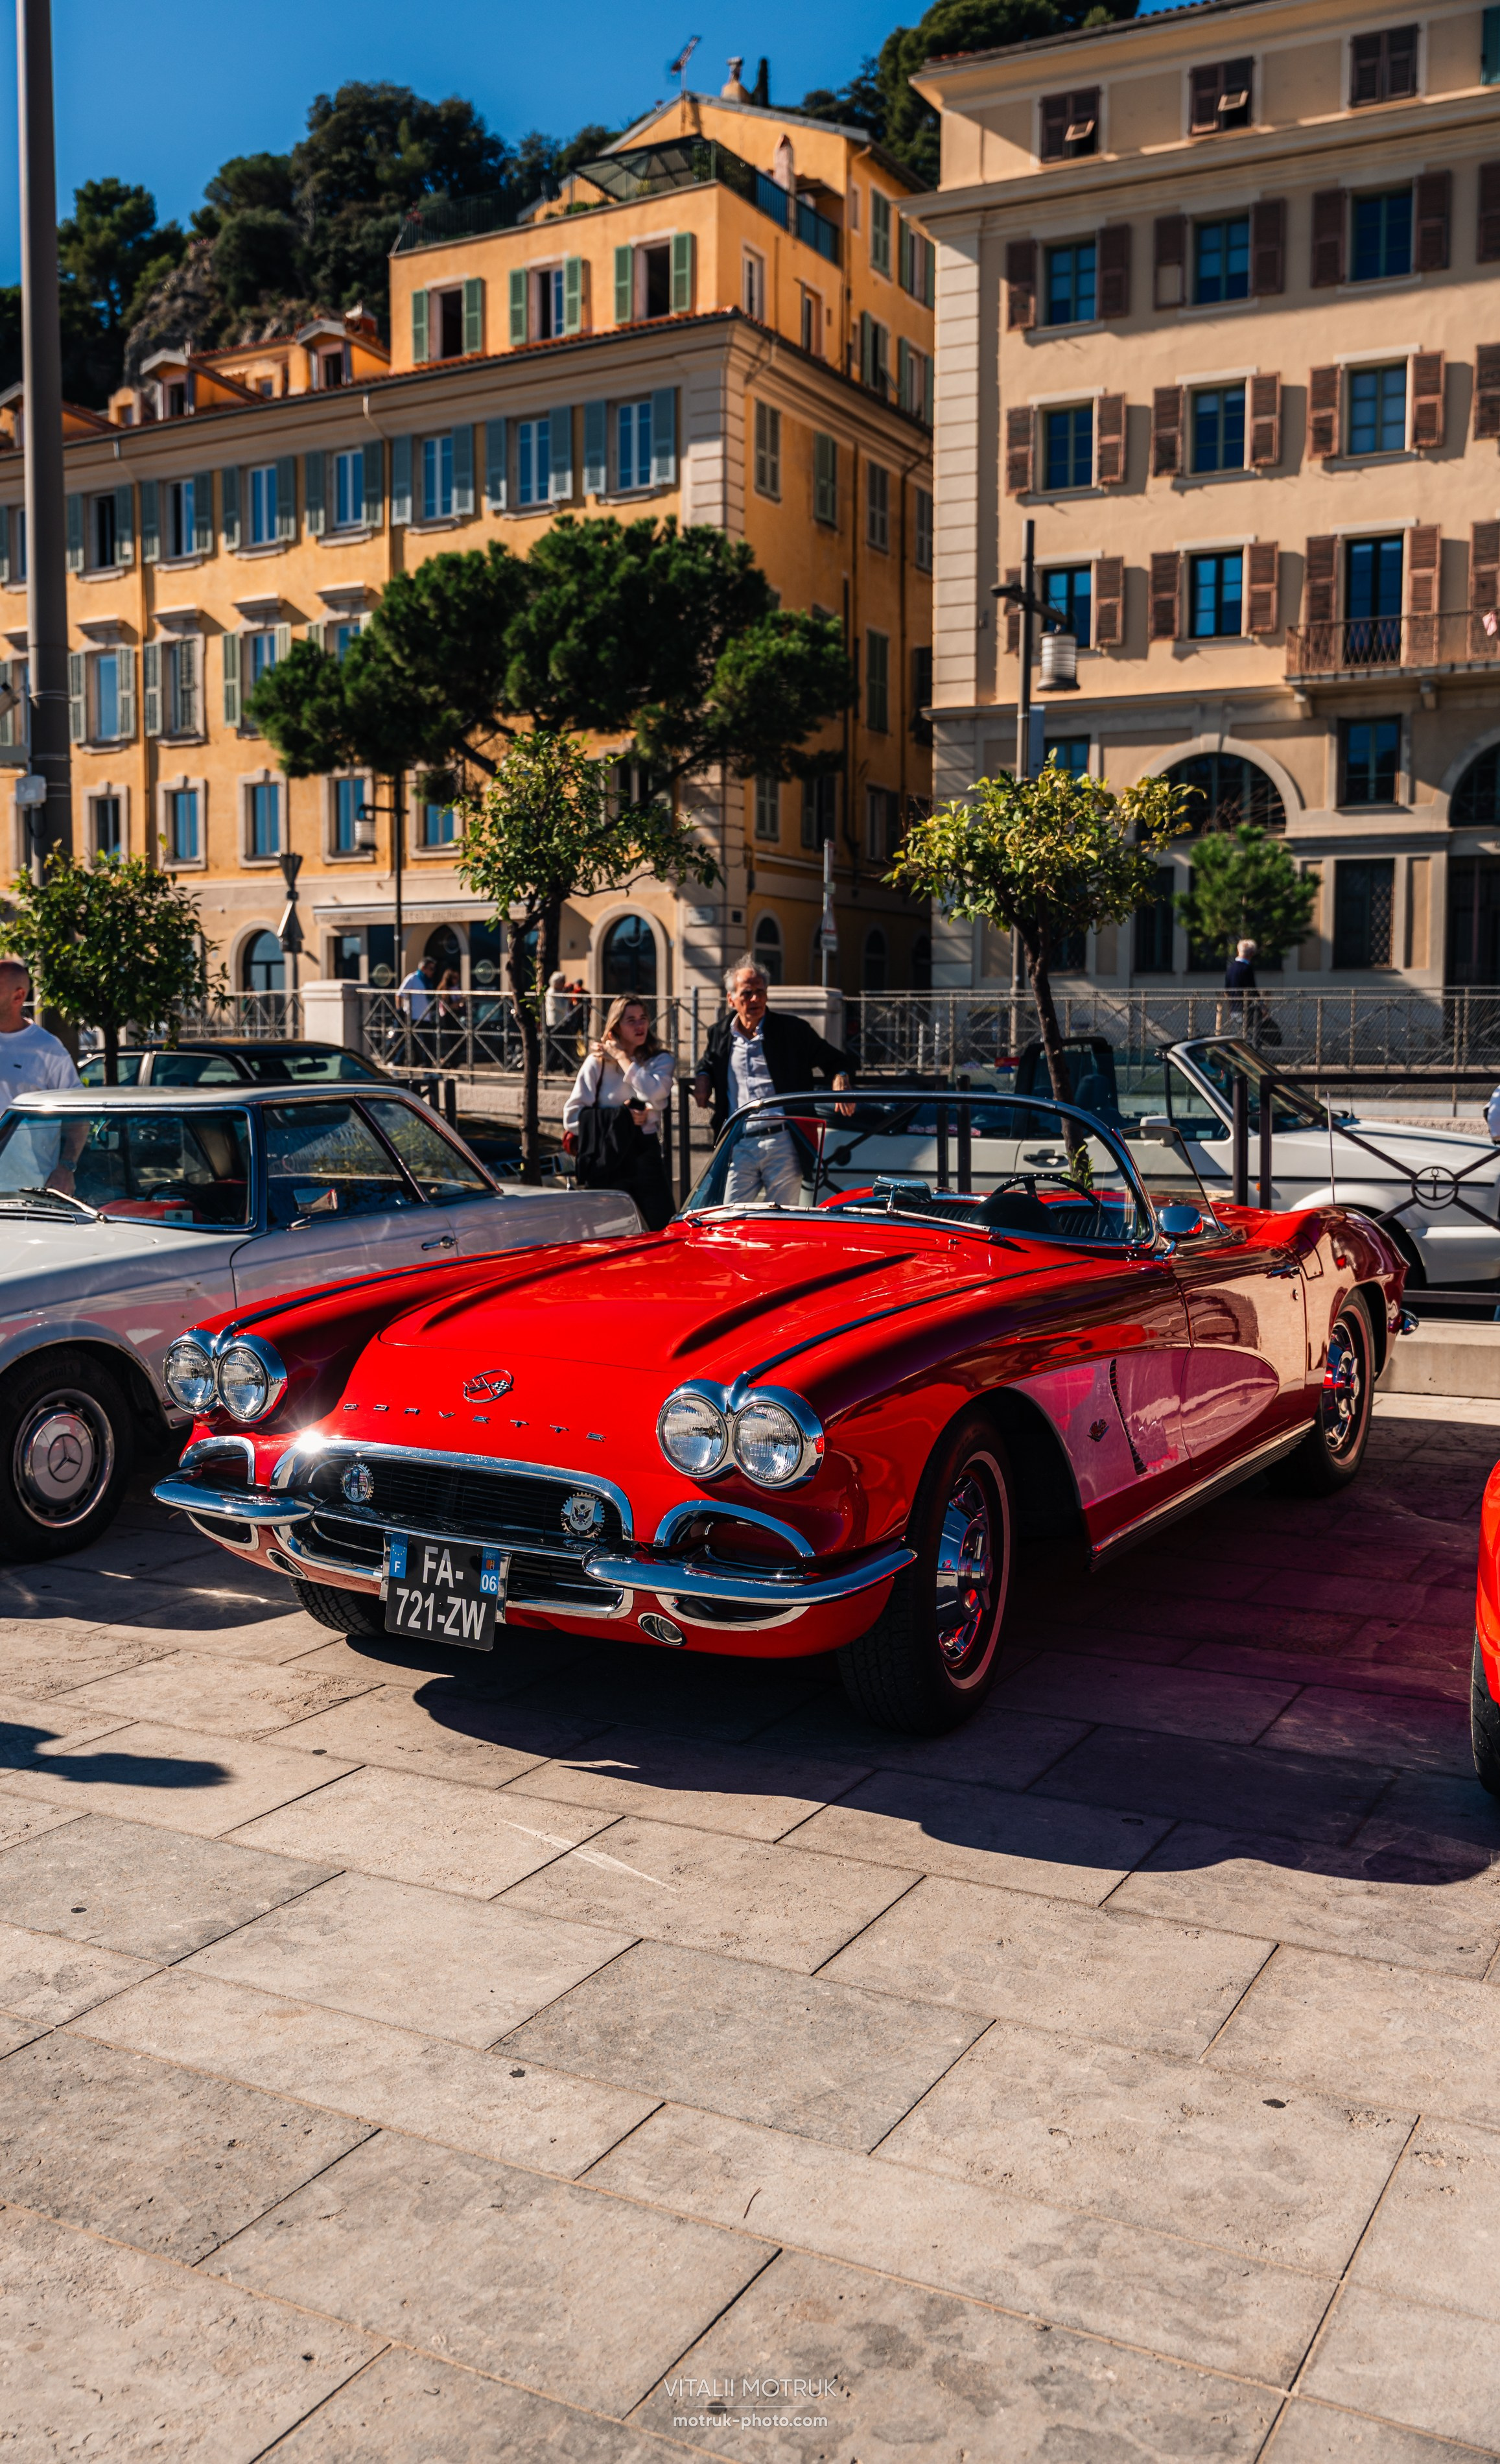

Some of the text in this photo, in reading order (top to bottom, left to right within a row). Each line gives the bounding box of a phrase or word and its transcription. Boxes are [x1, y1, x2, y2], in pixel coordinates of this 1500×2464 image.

[343, 1403, 606, 1442] CORVETTE
[394, 1561, 401, 1572] F
[482, 1574, 497, 1592] 06
[396, 1587, 487, 1640] 721-ZW
